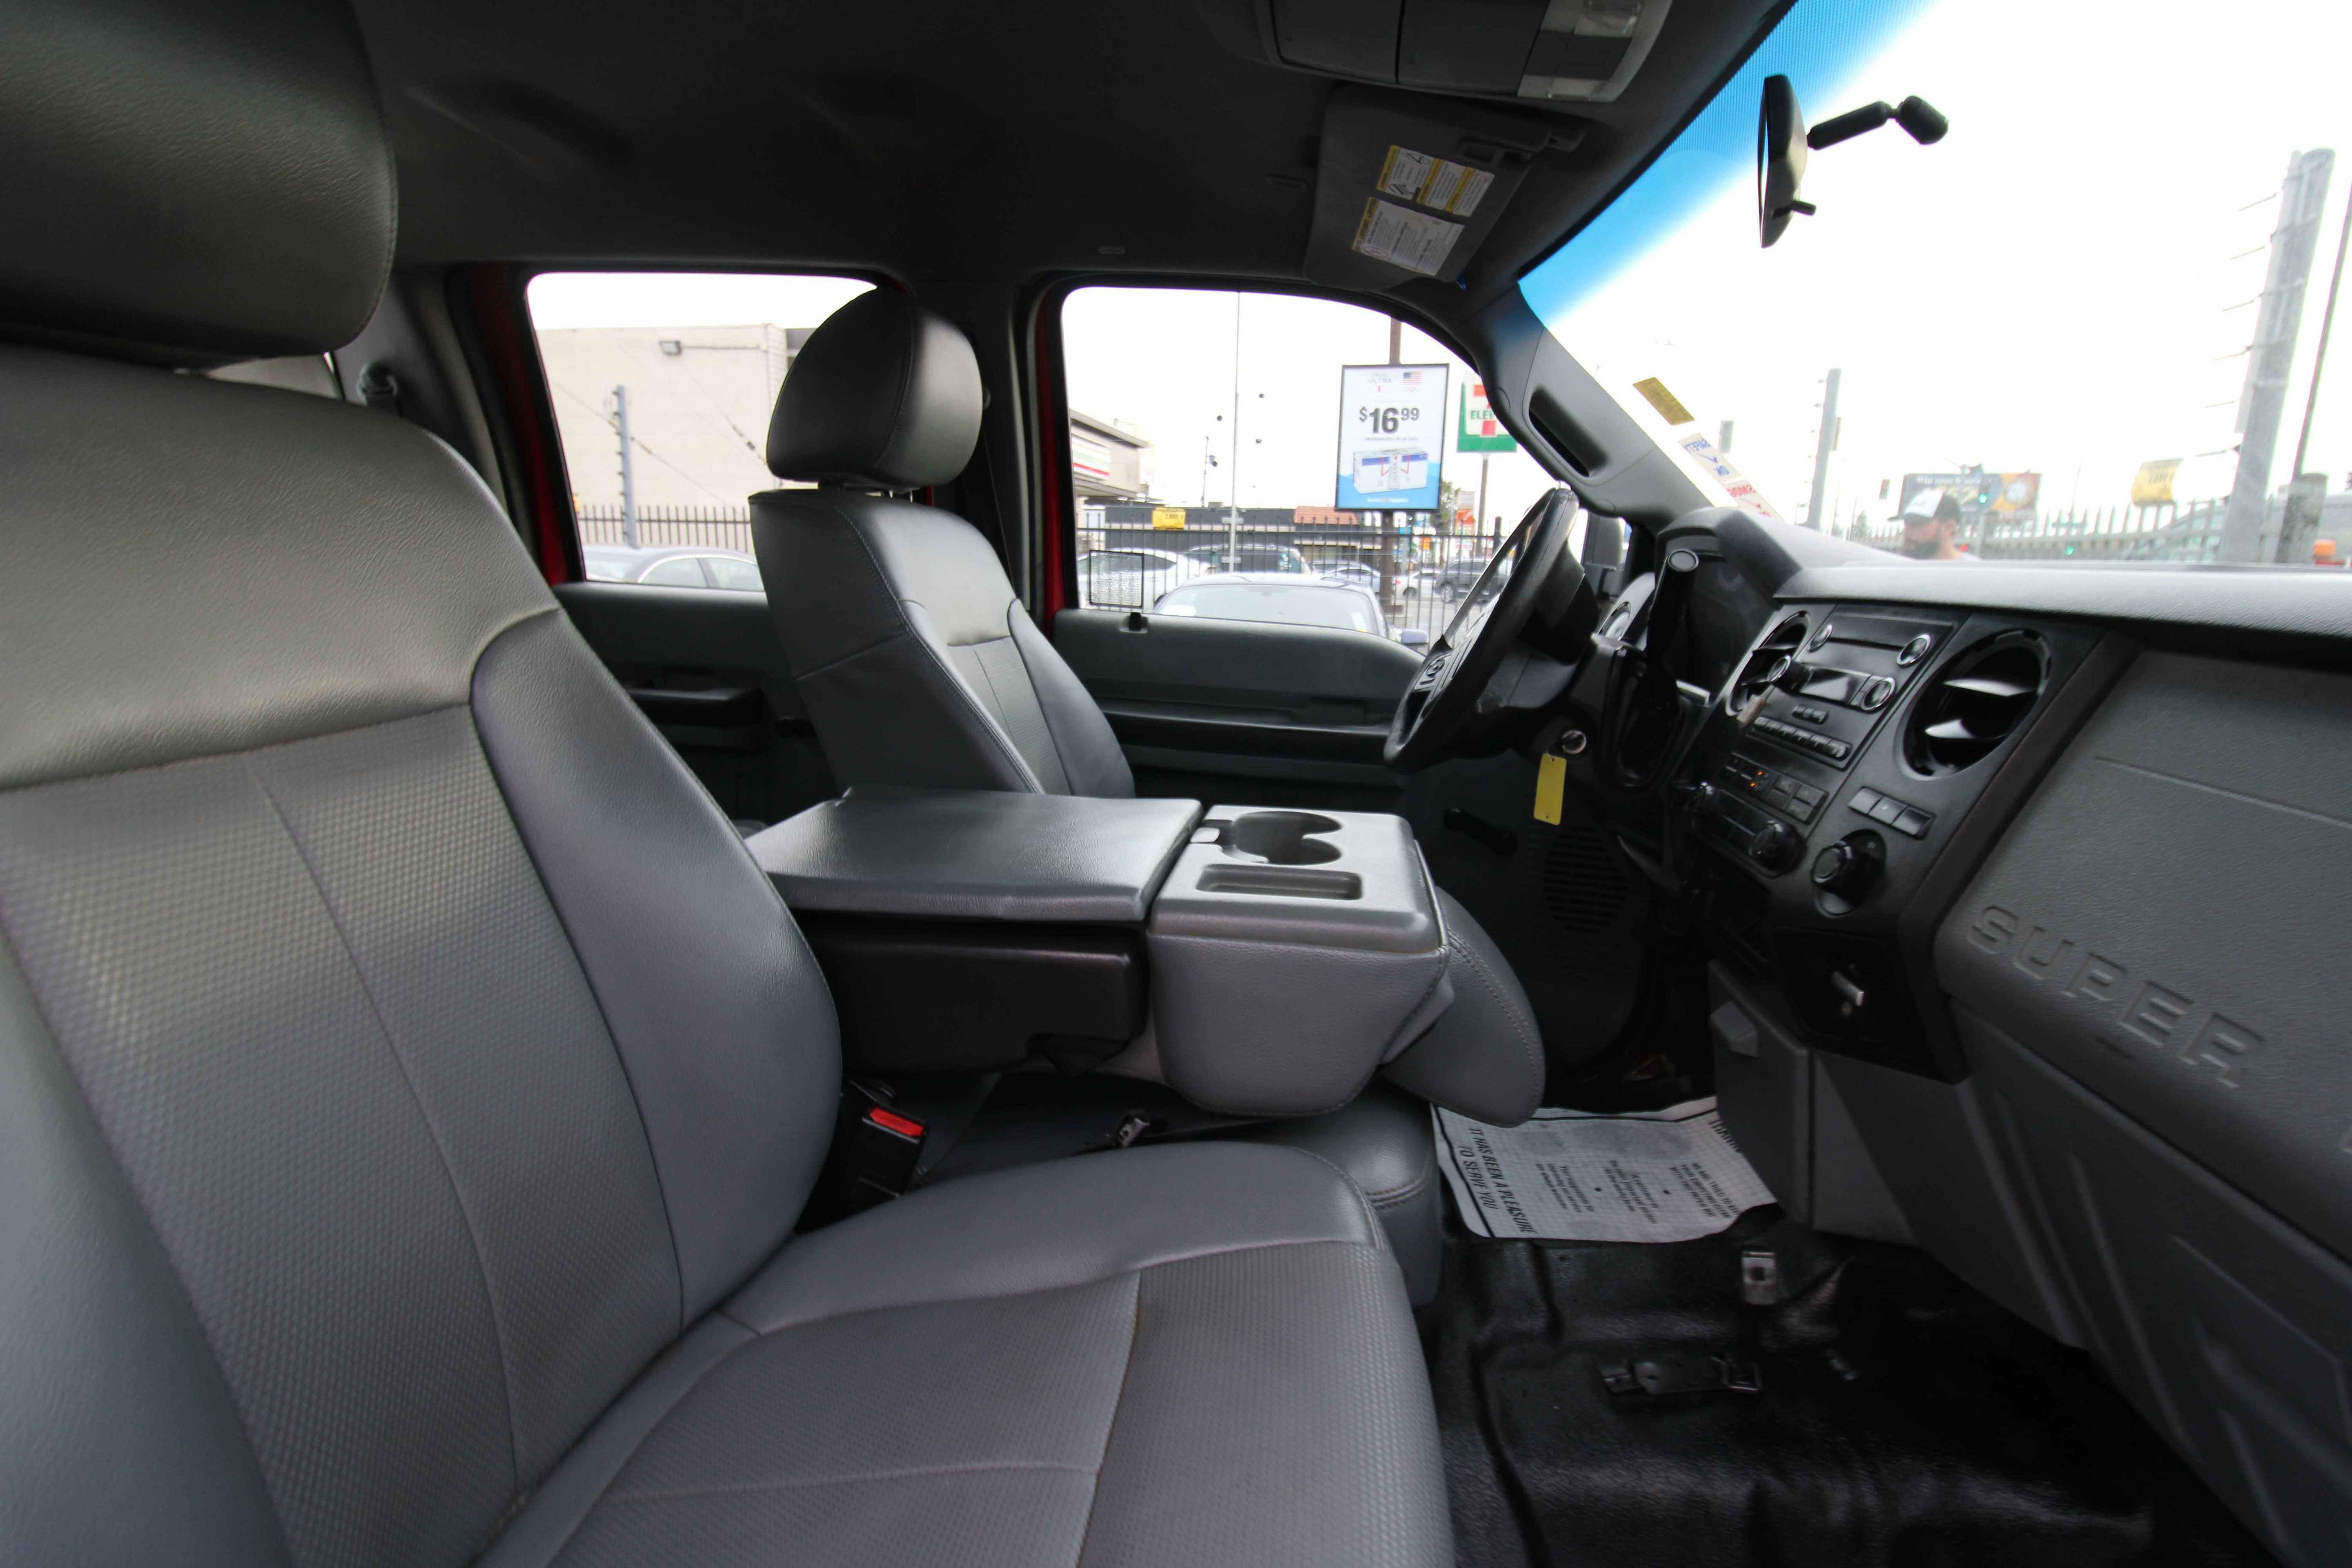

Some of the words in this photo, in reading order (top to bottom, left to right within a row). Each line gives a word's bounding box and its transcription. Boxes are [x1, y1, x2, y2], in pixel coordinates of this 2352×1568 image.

[1967, 905, 2266, 1089] SUPER
[1469, 1128, 1483, 1136] IT
[1458, 1145, 1474, 1158] TO
[1474, 1137, 1492, 1154] HAS
[1463, 1160, 1488, 1189] SERVE
[1481, 1155, 1505, 1180] BEEN
[1479, 1192, 1498, 1209] YOU
[1499, 1190, 1536, 1234] PLEASURE
